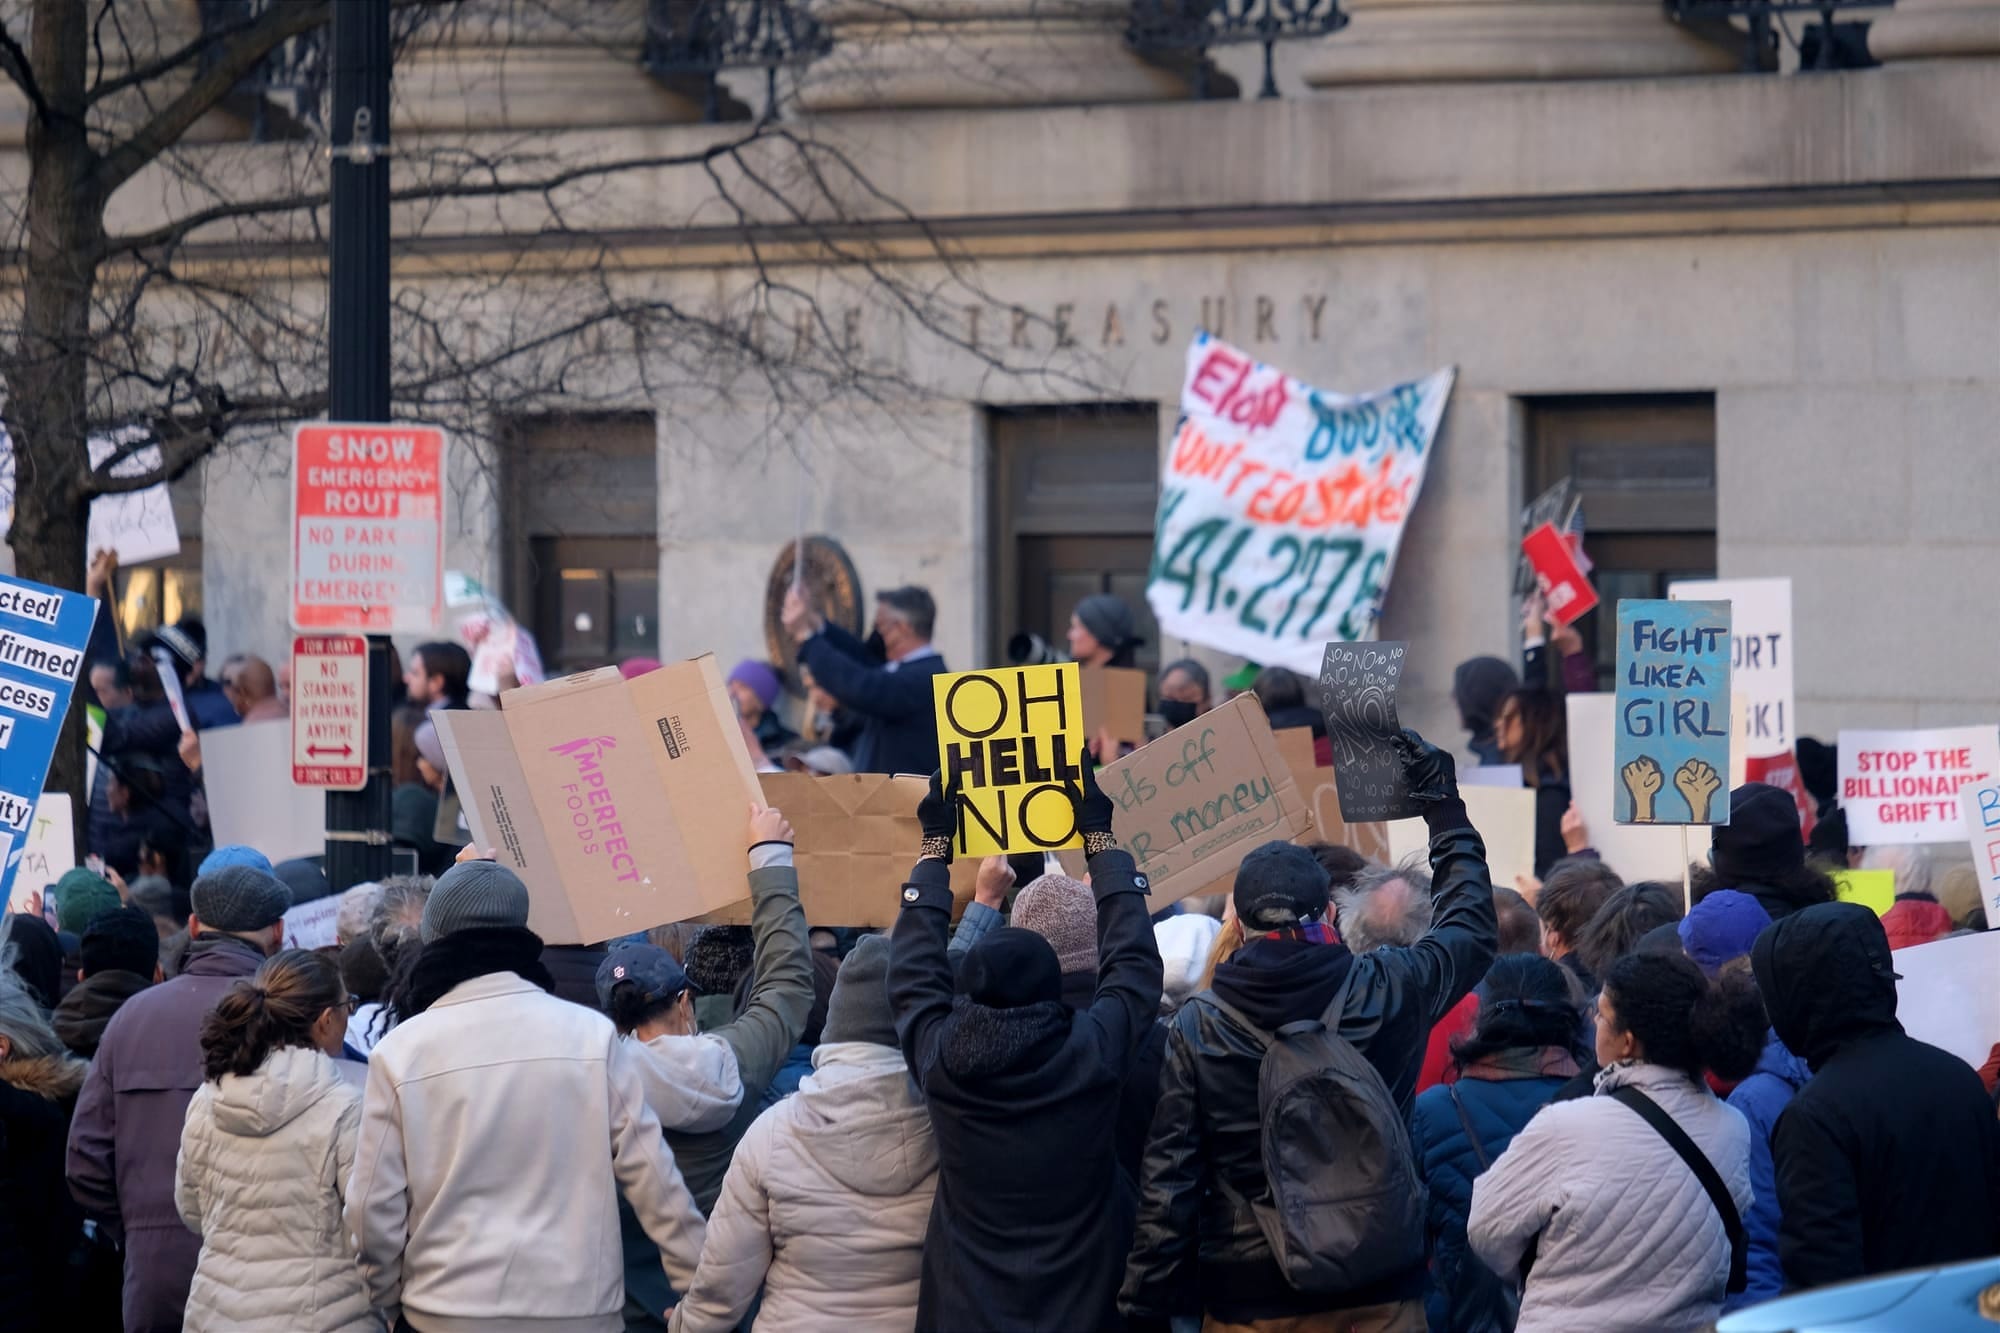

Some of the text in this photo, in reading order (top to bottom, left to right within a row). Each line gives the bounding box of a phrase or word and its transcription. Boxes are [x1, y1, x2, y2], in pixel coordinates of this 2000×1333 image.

[963, 294, 1328, 350] TREASURY
[327, 434, 415, 463] SNOW
[308, 466, 432, 488] EMERGENCY
[325, 489, 413, 514] ROUT
[308, 526, 425, 546] NO PARK
[328, 552, 405, 574] DURIN
[1633, 620, 1727, 655] FIGHT
[320, 661, 338, 678] NO
[1353, 649, 1376, 672] NO
[1629, 662, 1705, 688] LIKE A
[303, 682, 357, 698] STANDING
[311, 703, 358, 720] PARKING
[945, 668, 1066, 739] OH
[1328, 686, 1392, 766] NO
[1624, 698, 1727, 738] GIRL
[307, 723, 352, 741] ANYTIME
[670, 715, 690, 754] FRAGILE
[947, 734, 1080, 791] HELL
[1165, 728, 1215, 786] off
[1858, 748, 1972, 772] STOP THE
[1844, 773, 1989, 799] BILLIONAI
[561, 783, 599, 855] FOODS
[955, 784, 1081, 854] NO
[1170, 776, 1280, 840] money
[1878, 801, 1958, 823] GRIFT!
